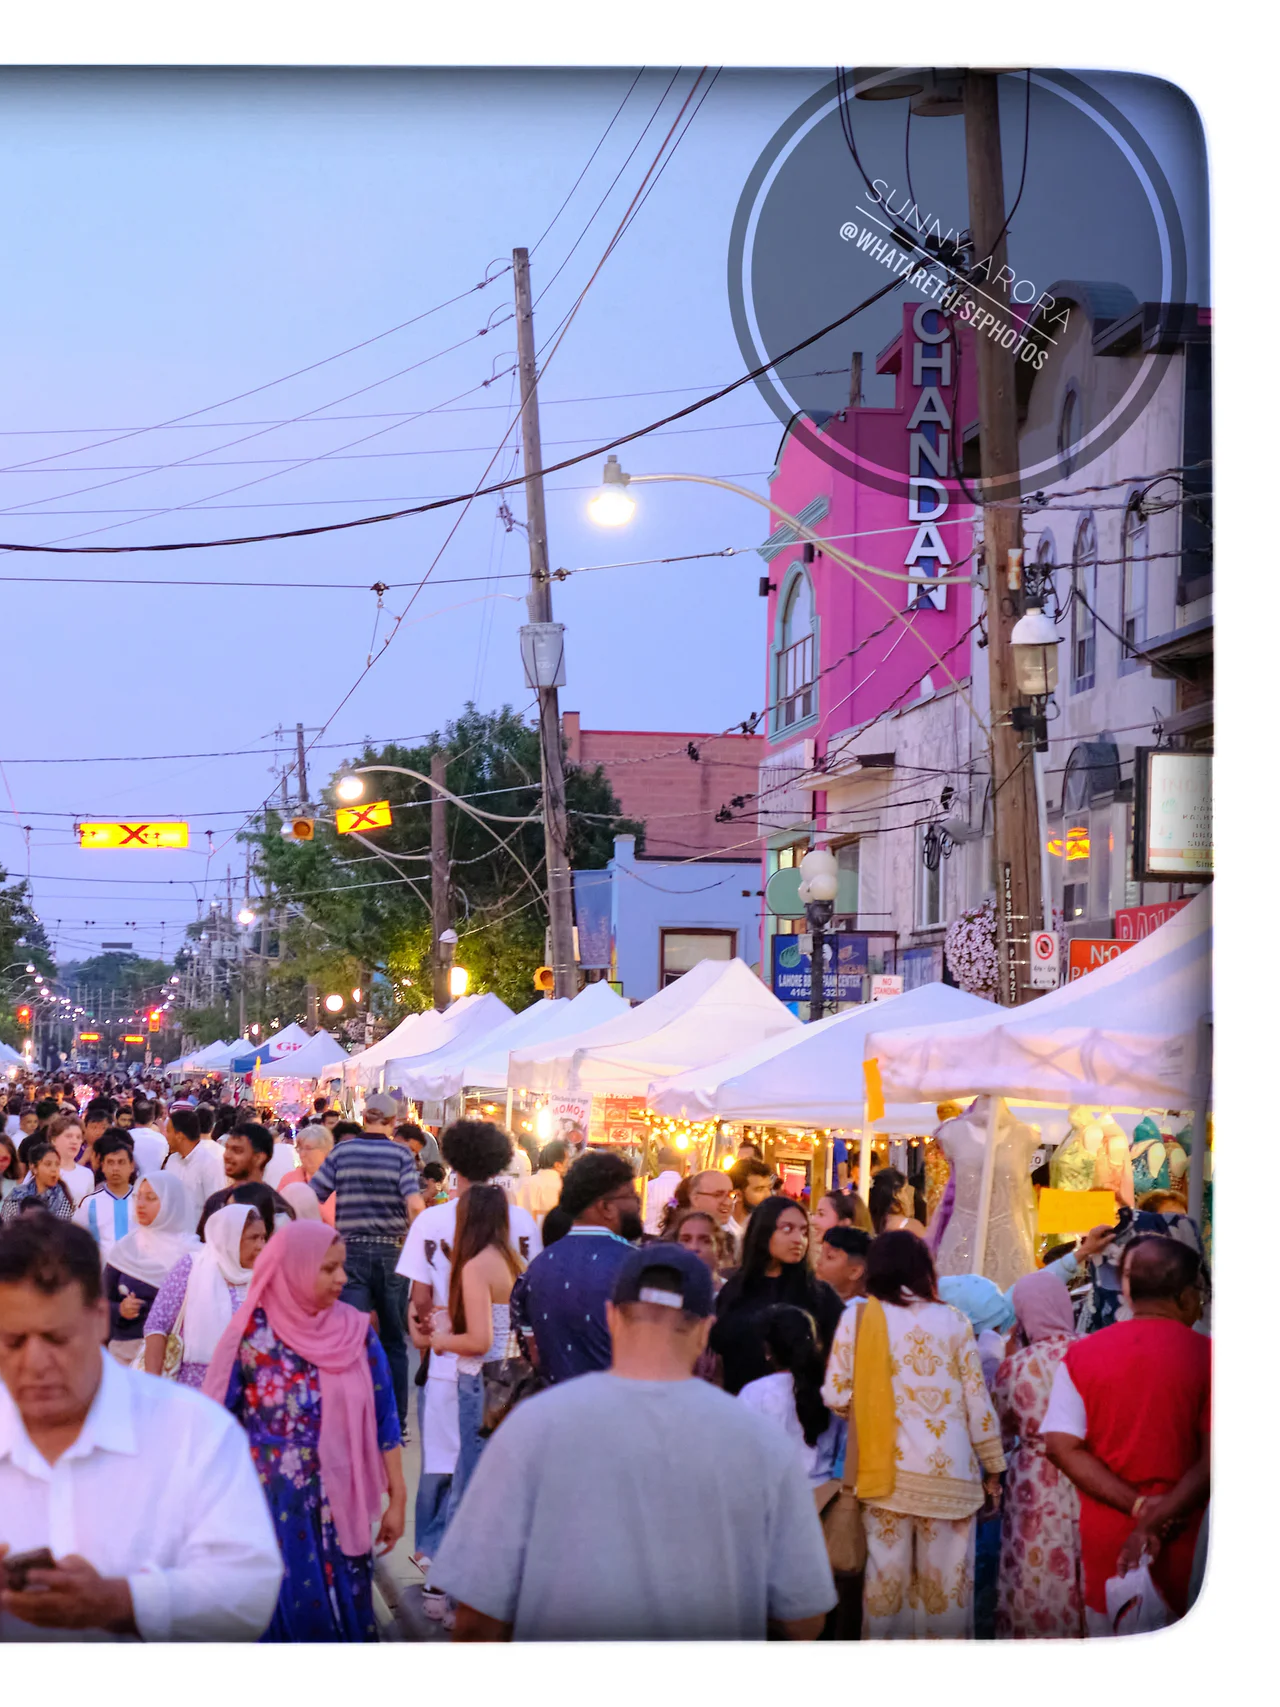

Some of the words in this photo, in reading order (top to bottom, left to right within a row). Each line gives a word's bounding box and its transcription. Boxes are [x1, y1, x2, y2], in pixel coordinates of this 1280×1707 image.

[903, 302, 952, 612] CHANDAN
[1091, 944, 1122, 965] NO
[882, 978, 893, 986] NO
[873, 987, 901, 996] STANDING
[553, 1104, 585, 1119] MOMOS
